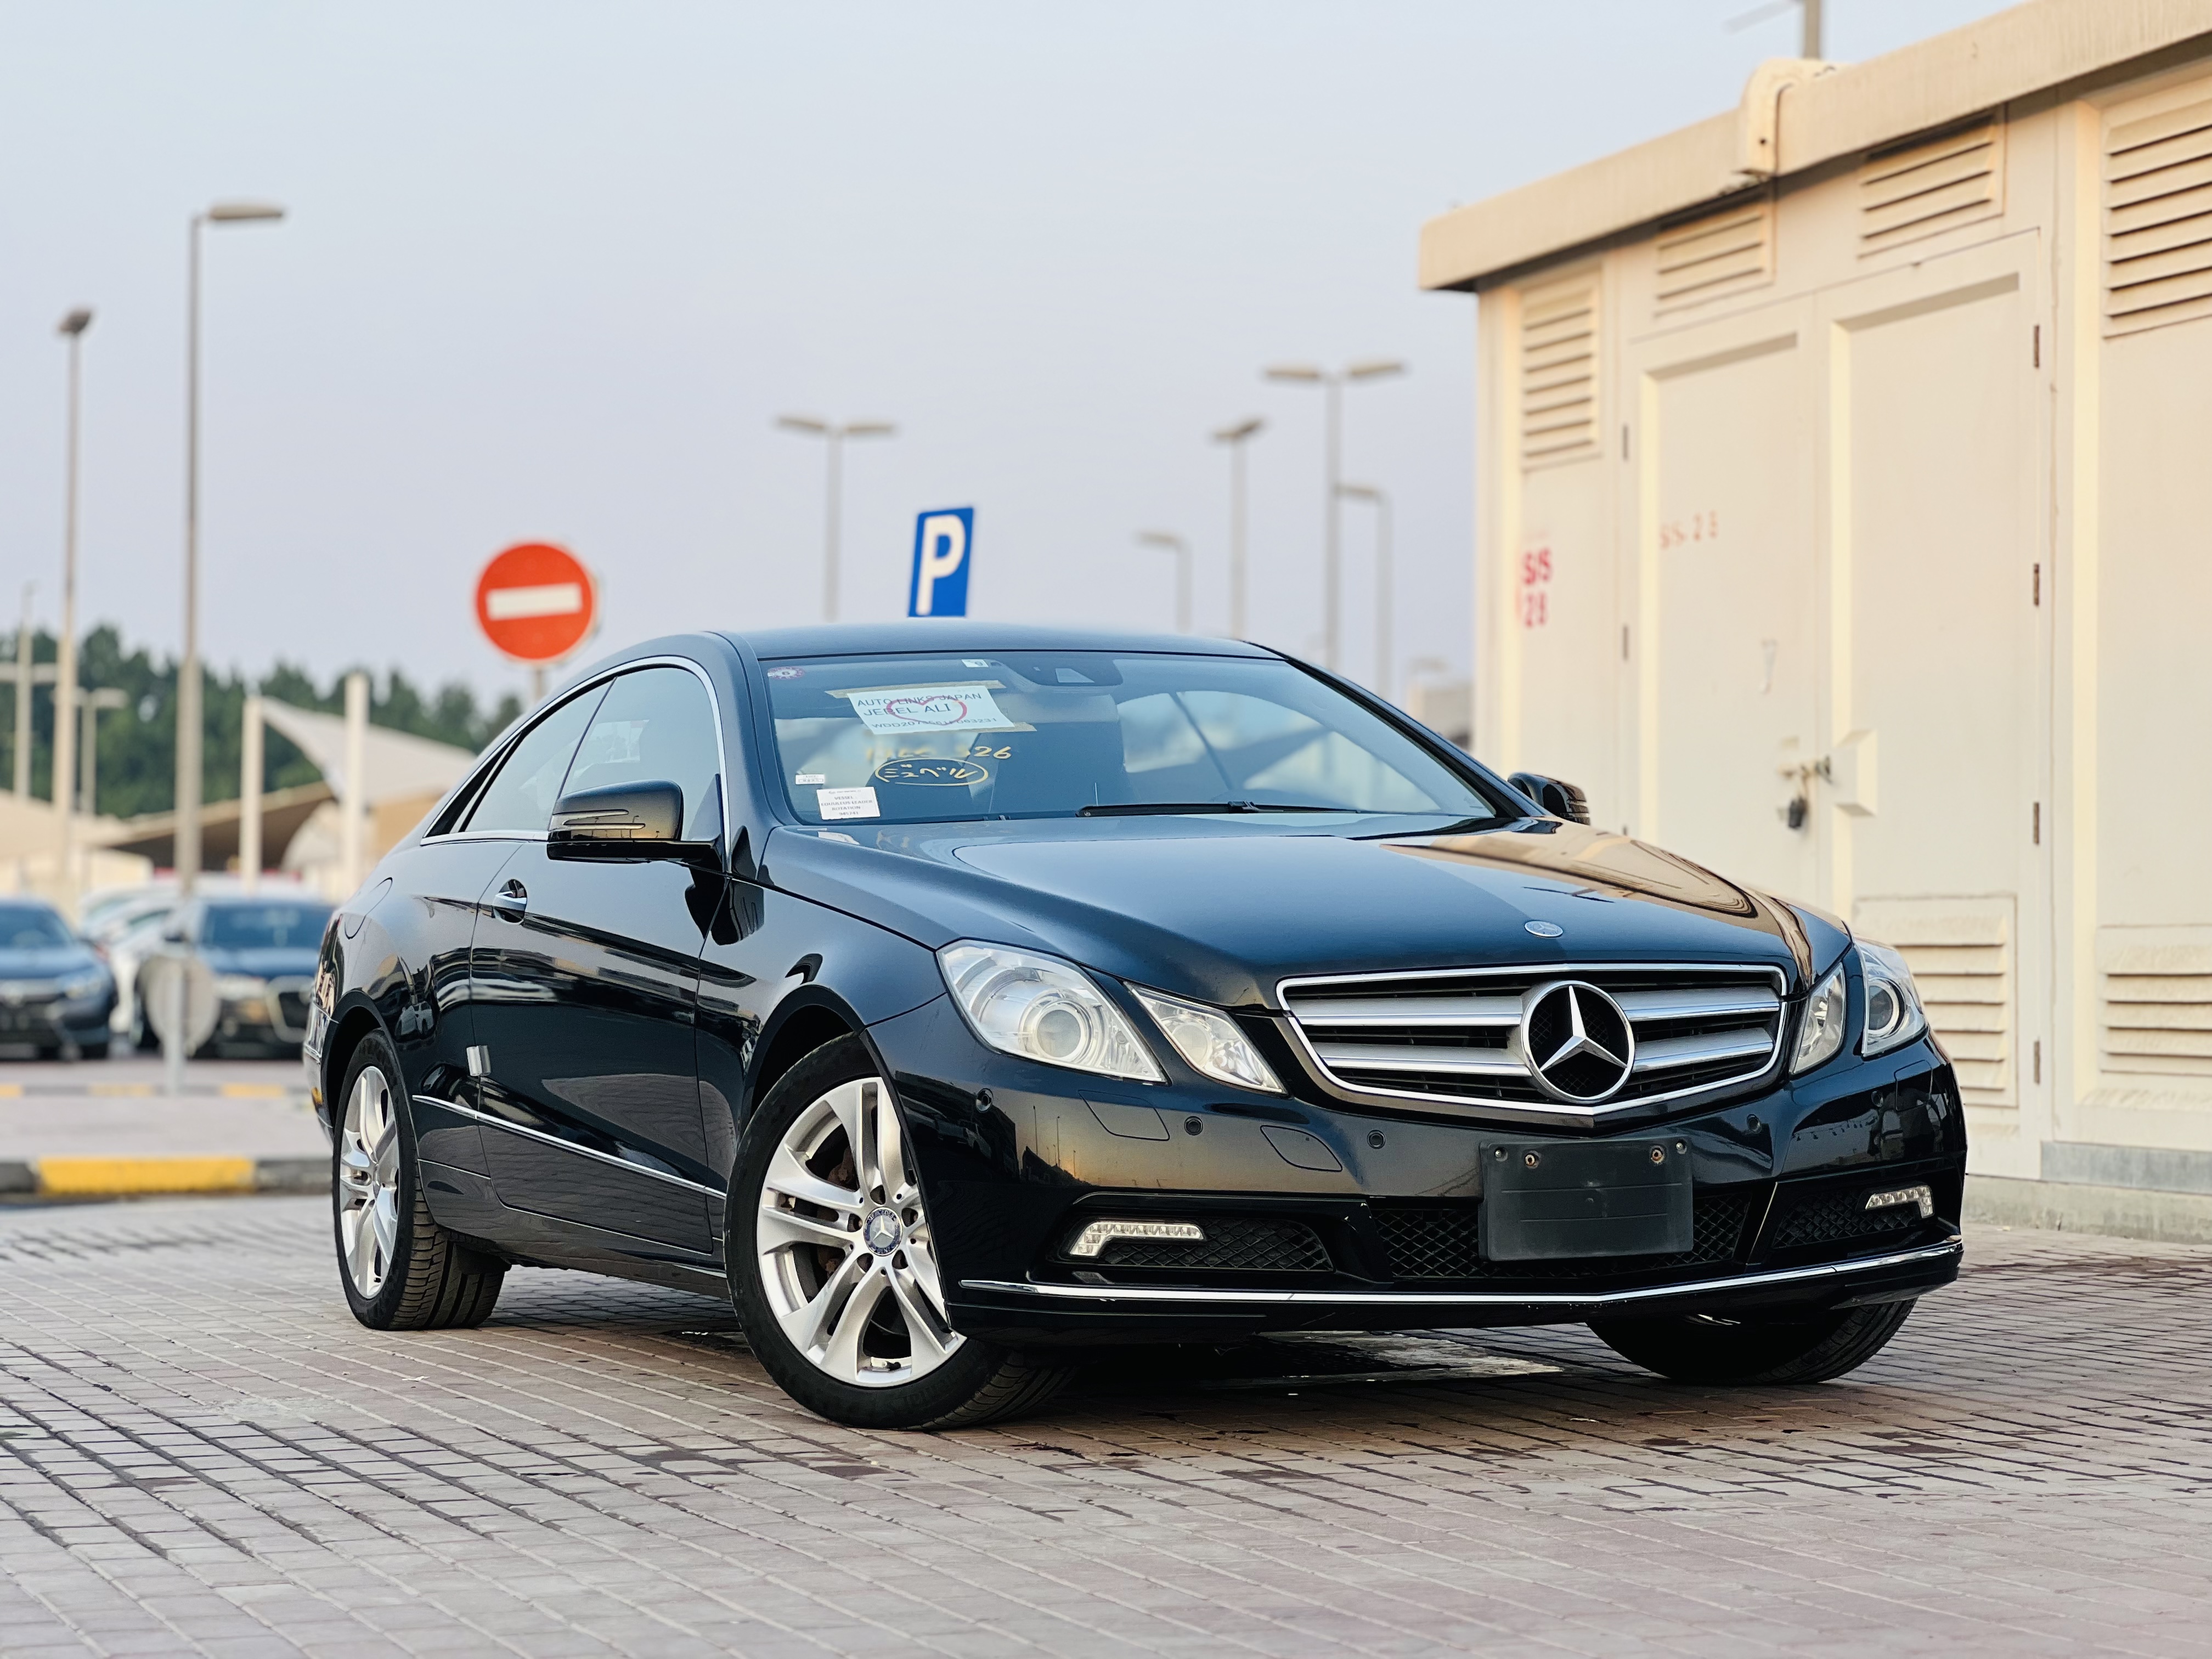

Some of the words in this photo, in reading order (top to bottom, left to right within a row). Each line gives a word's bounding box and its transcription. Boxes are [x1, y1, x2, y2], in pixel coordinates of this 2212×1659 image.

[916, 514, 966, 616] P
[1523, 548, 1551, 585] SS
[857, 698, 892, 707] AUTO
[897, 695, 935, 704] LINKS
[939, 692, 982, 701] JAPAN
[924, 703, 951, 713] ALI
[868, 1209, 894, 1221] MERCEDES
